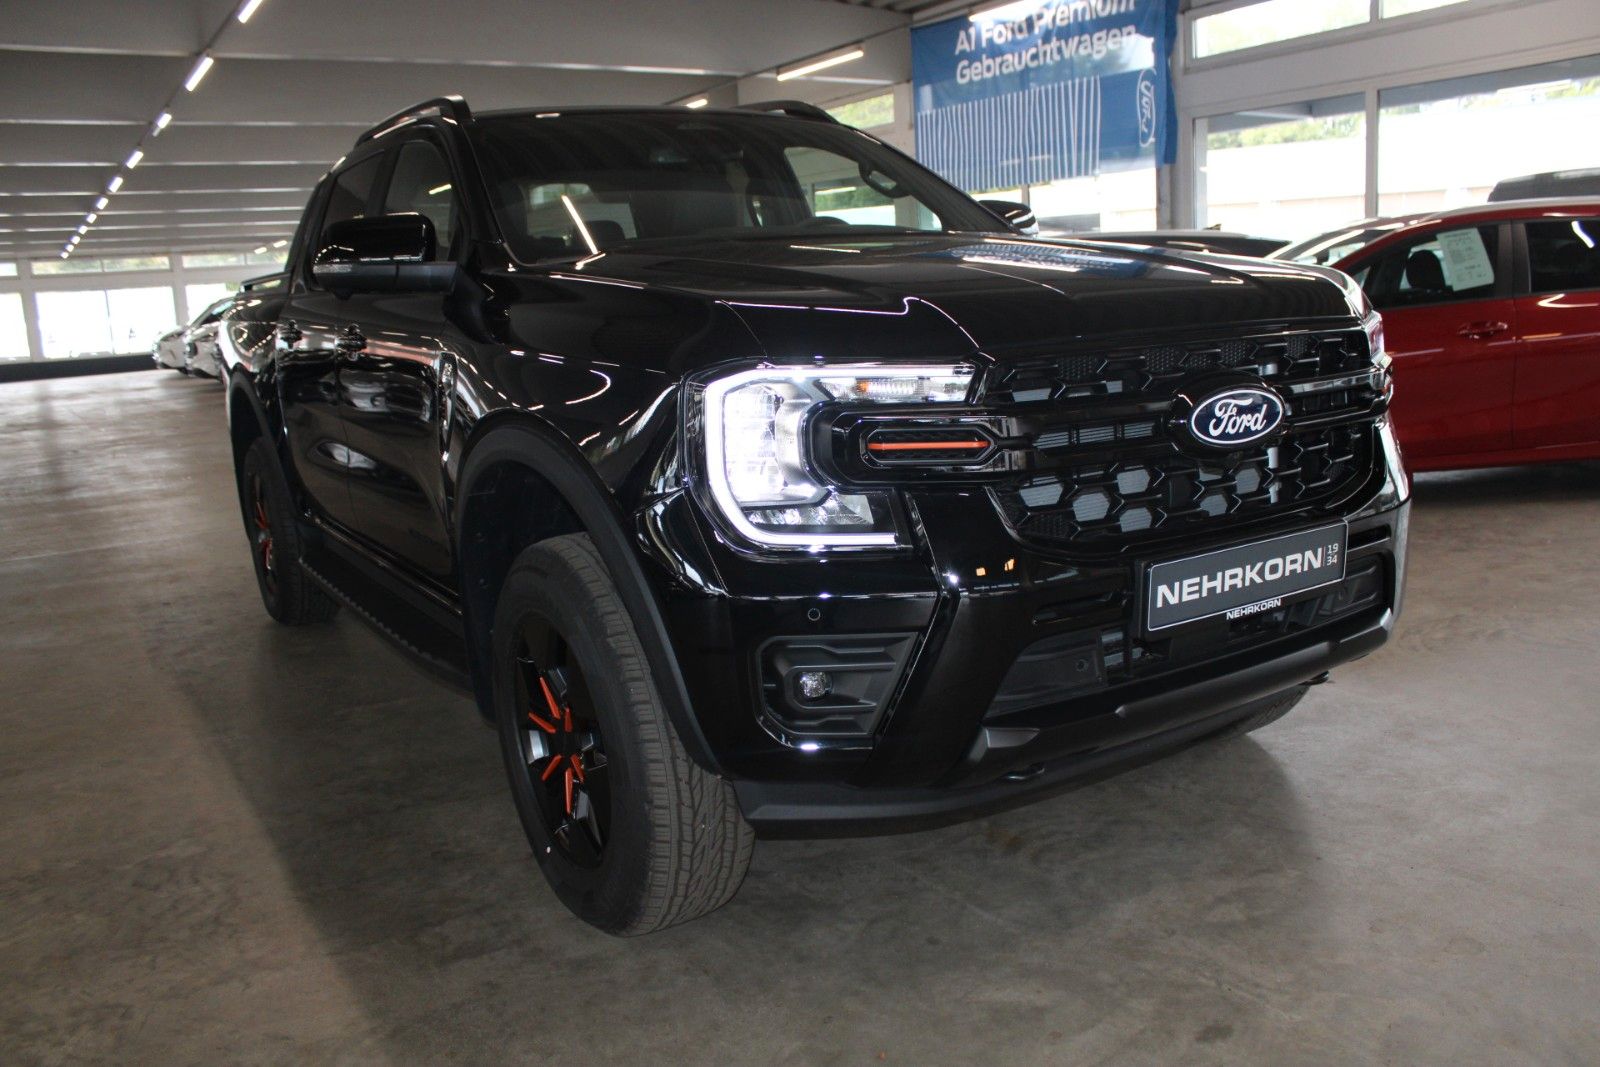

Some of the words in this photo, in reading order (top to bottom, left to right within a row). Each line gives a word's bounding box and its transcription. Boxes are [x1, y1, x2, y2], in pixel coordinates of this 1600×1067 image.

[981, 16, 1029, 48] Ford
[1034, 0, 1135, 35] Premium
[956, 24, 1136, 84] Gebrauchtwagen
[1208, 397, 1268, 437] Ford
[1326, 555, 1338, 566] 34
[1327, 543, 1339, 554] 19
[1156, 547, 1322, 608] NEHRKORN
[1226, 598, 1282, 620] NEHRKORN
